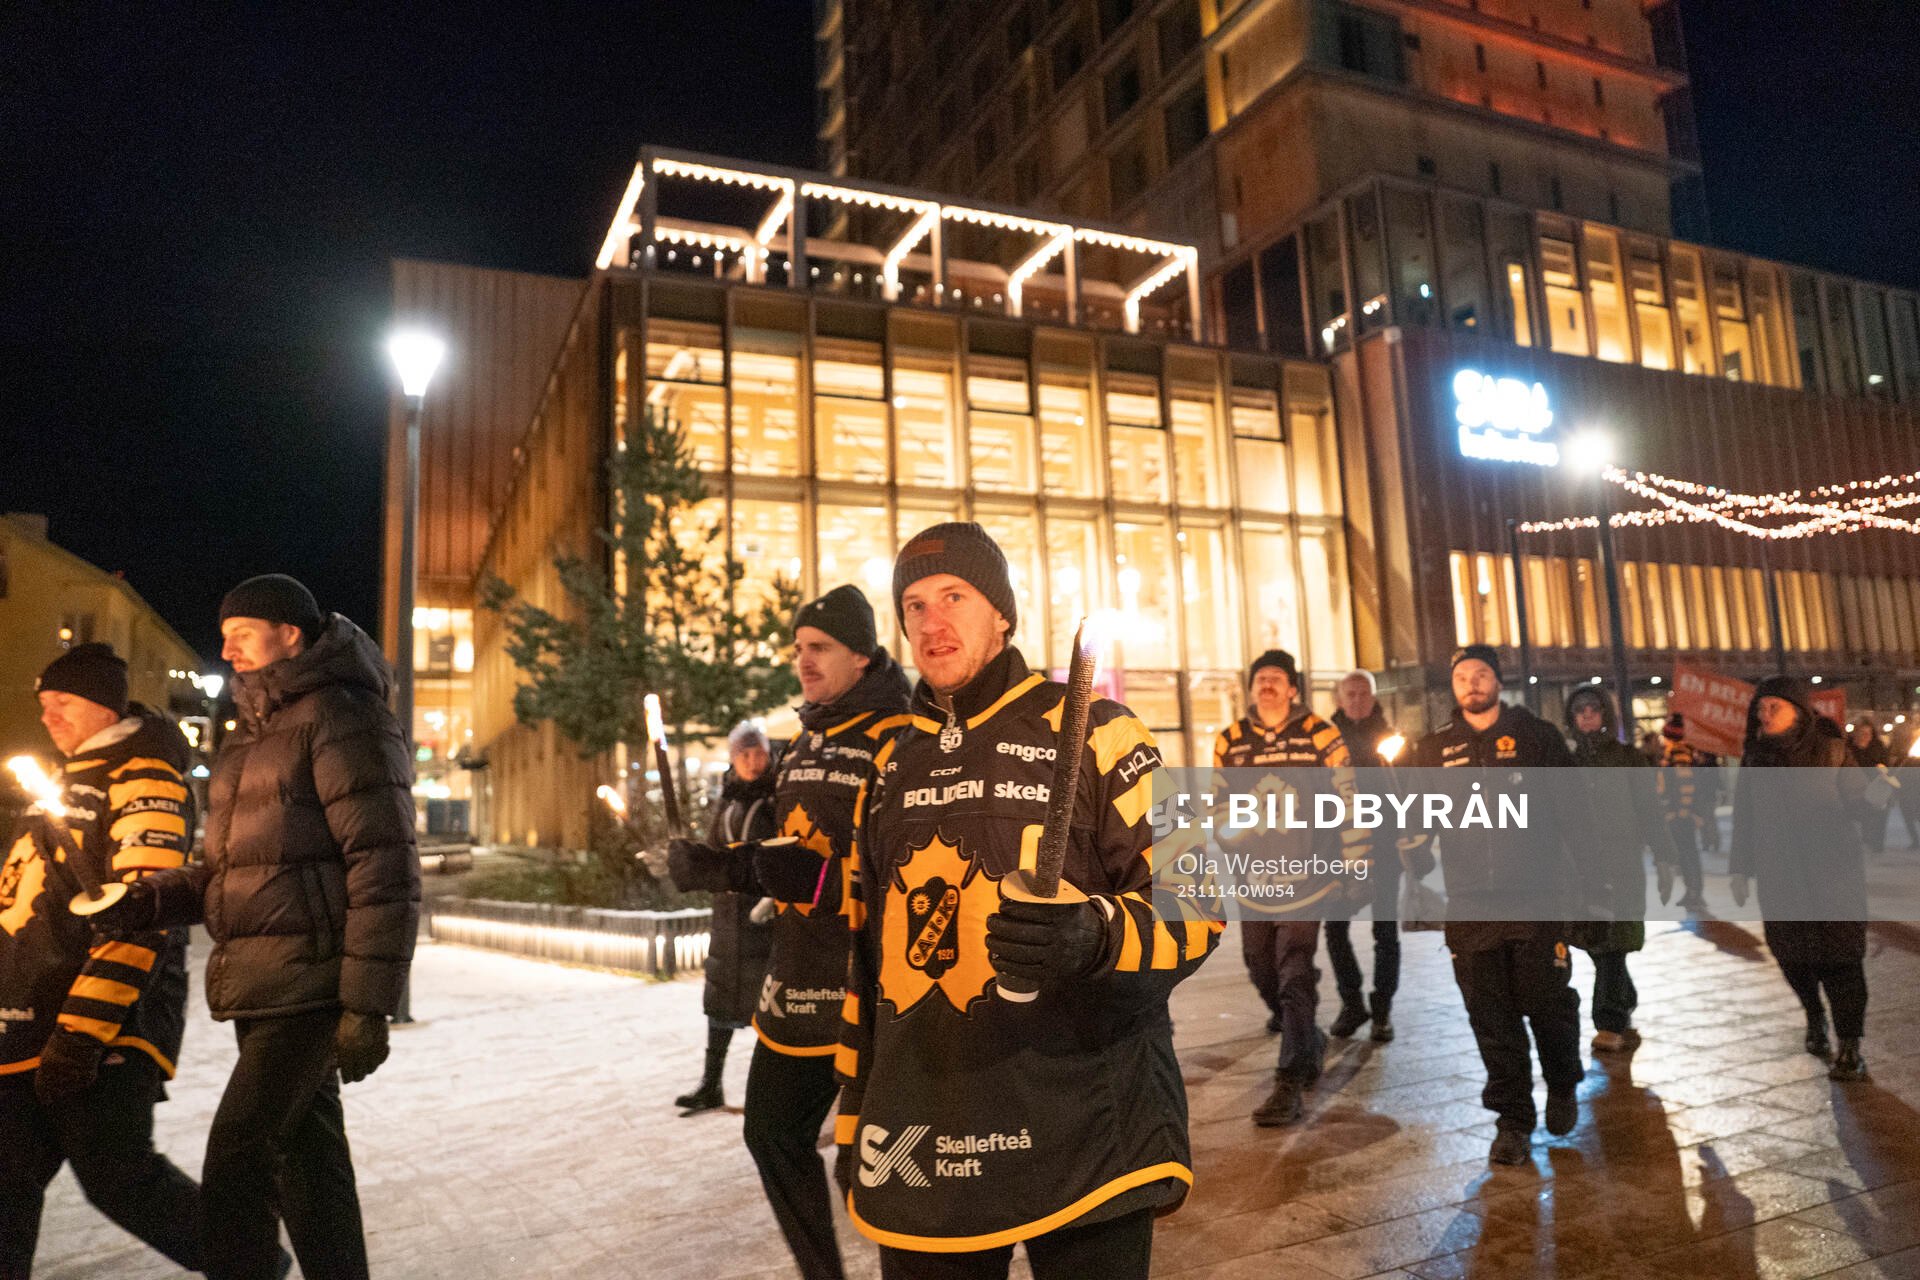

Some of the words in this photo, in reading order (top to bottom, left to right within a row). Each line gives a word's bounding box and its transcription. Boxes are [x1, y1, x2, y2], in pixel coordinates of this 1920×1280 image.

[939, 733, 964, 751] 50
[903, 780, 984, 808] BOLIDEN
[785, 986, 846, 1000] Skellefteå
[785, 1002, 816, 1014] Kraft
[935, 1128, 1032, 1155] Skellefteå
[935, 1158, 983, 1178] Kraft
